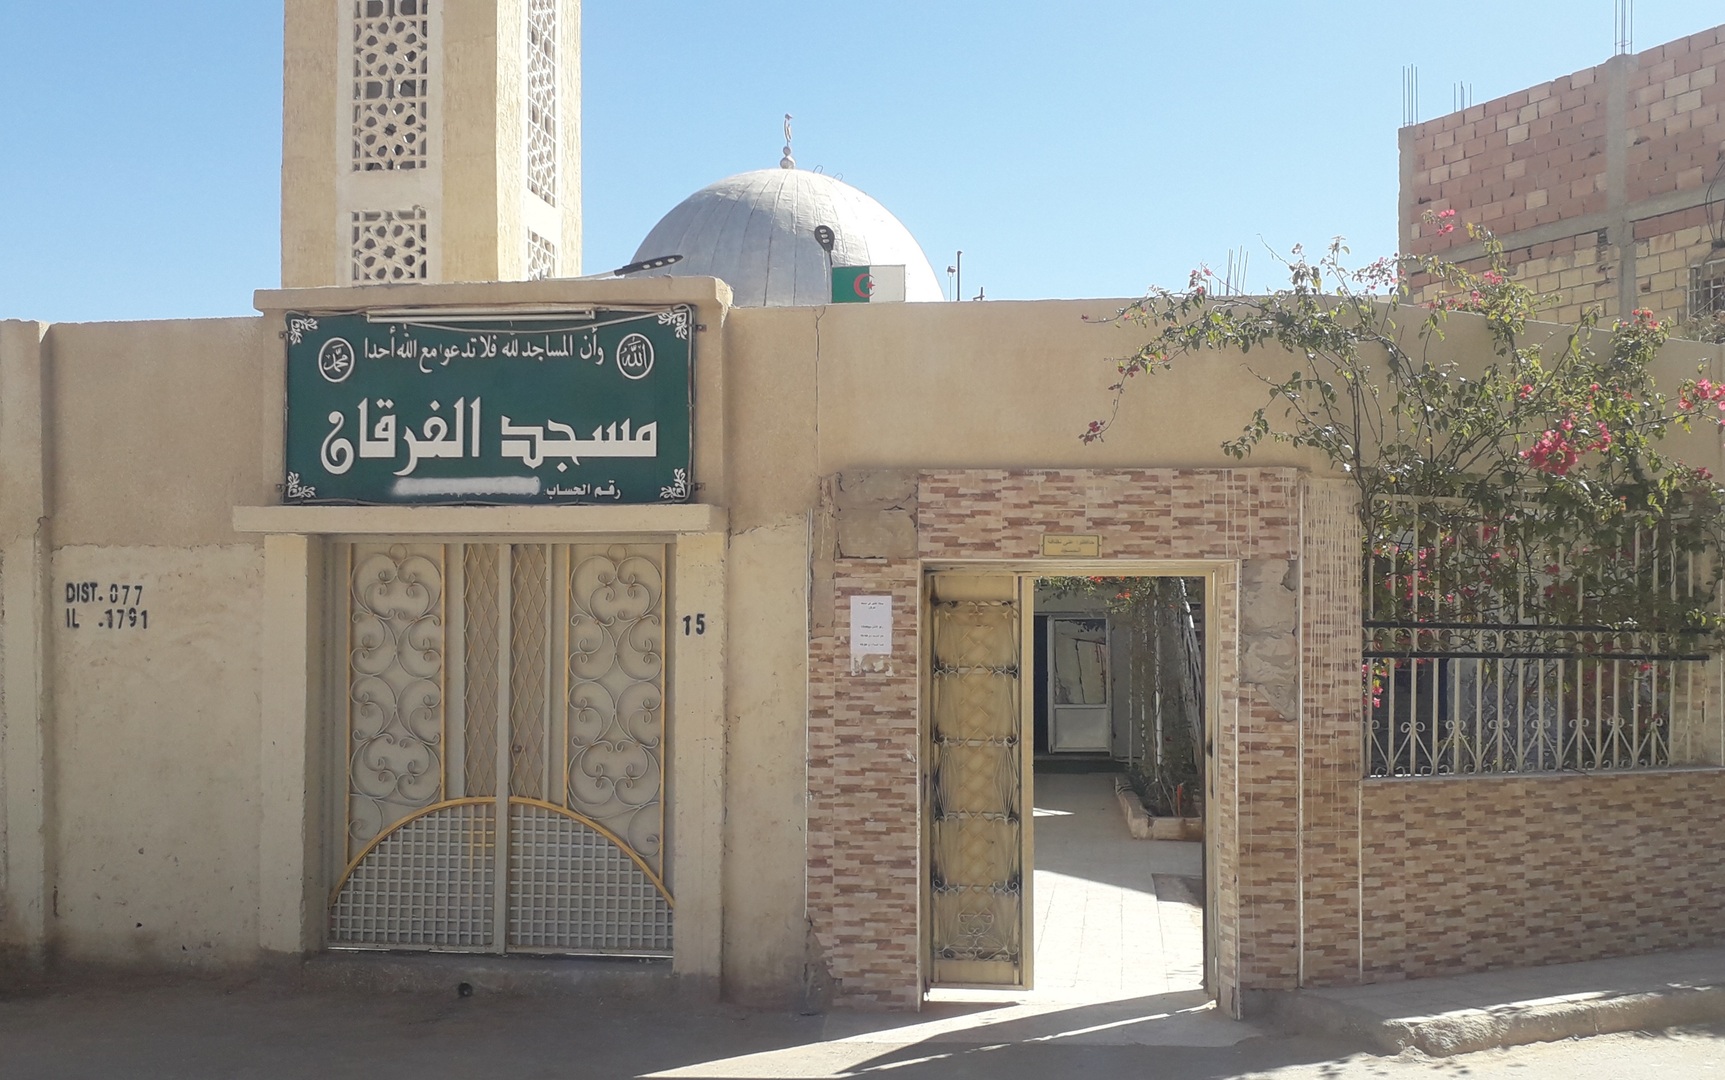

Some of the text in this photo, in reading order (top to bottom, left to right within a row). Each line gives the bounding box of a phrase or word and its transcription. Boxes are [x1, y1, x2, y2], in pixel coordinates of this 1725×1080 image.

[364, 325, 396, 359] أحدا
[396, 326, 418, 359] الله
[480, 334, 498, 358] فلا
[521, 334, 573, 362] المساجد
[579, 326, 605, 366] وأن
[419, 347, 437, 374] مع
[320, 396, 657, 476] مسجد الفرقان
[594, 479, 622, 499] رقم
[66, 582, 143, 605] DIST. 077
[683, 613, 705, 636] 15
